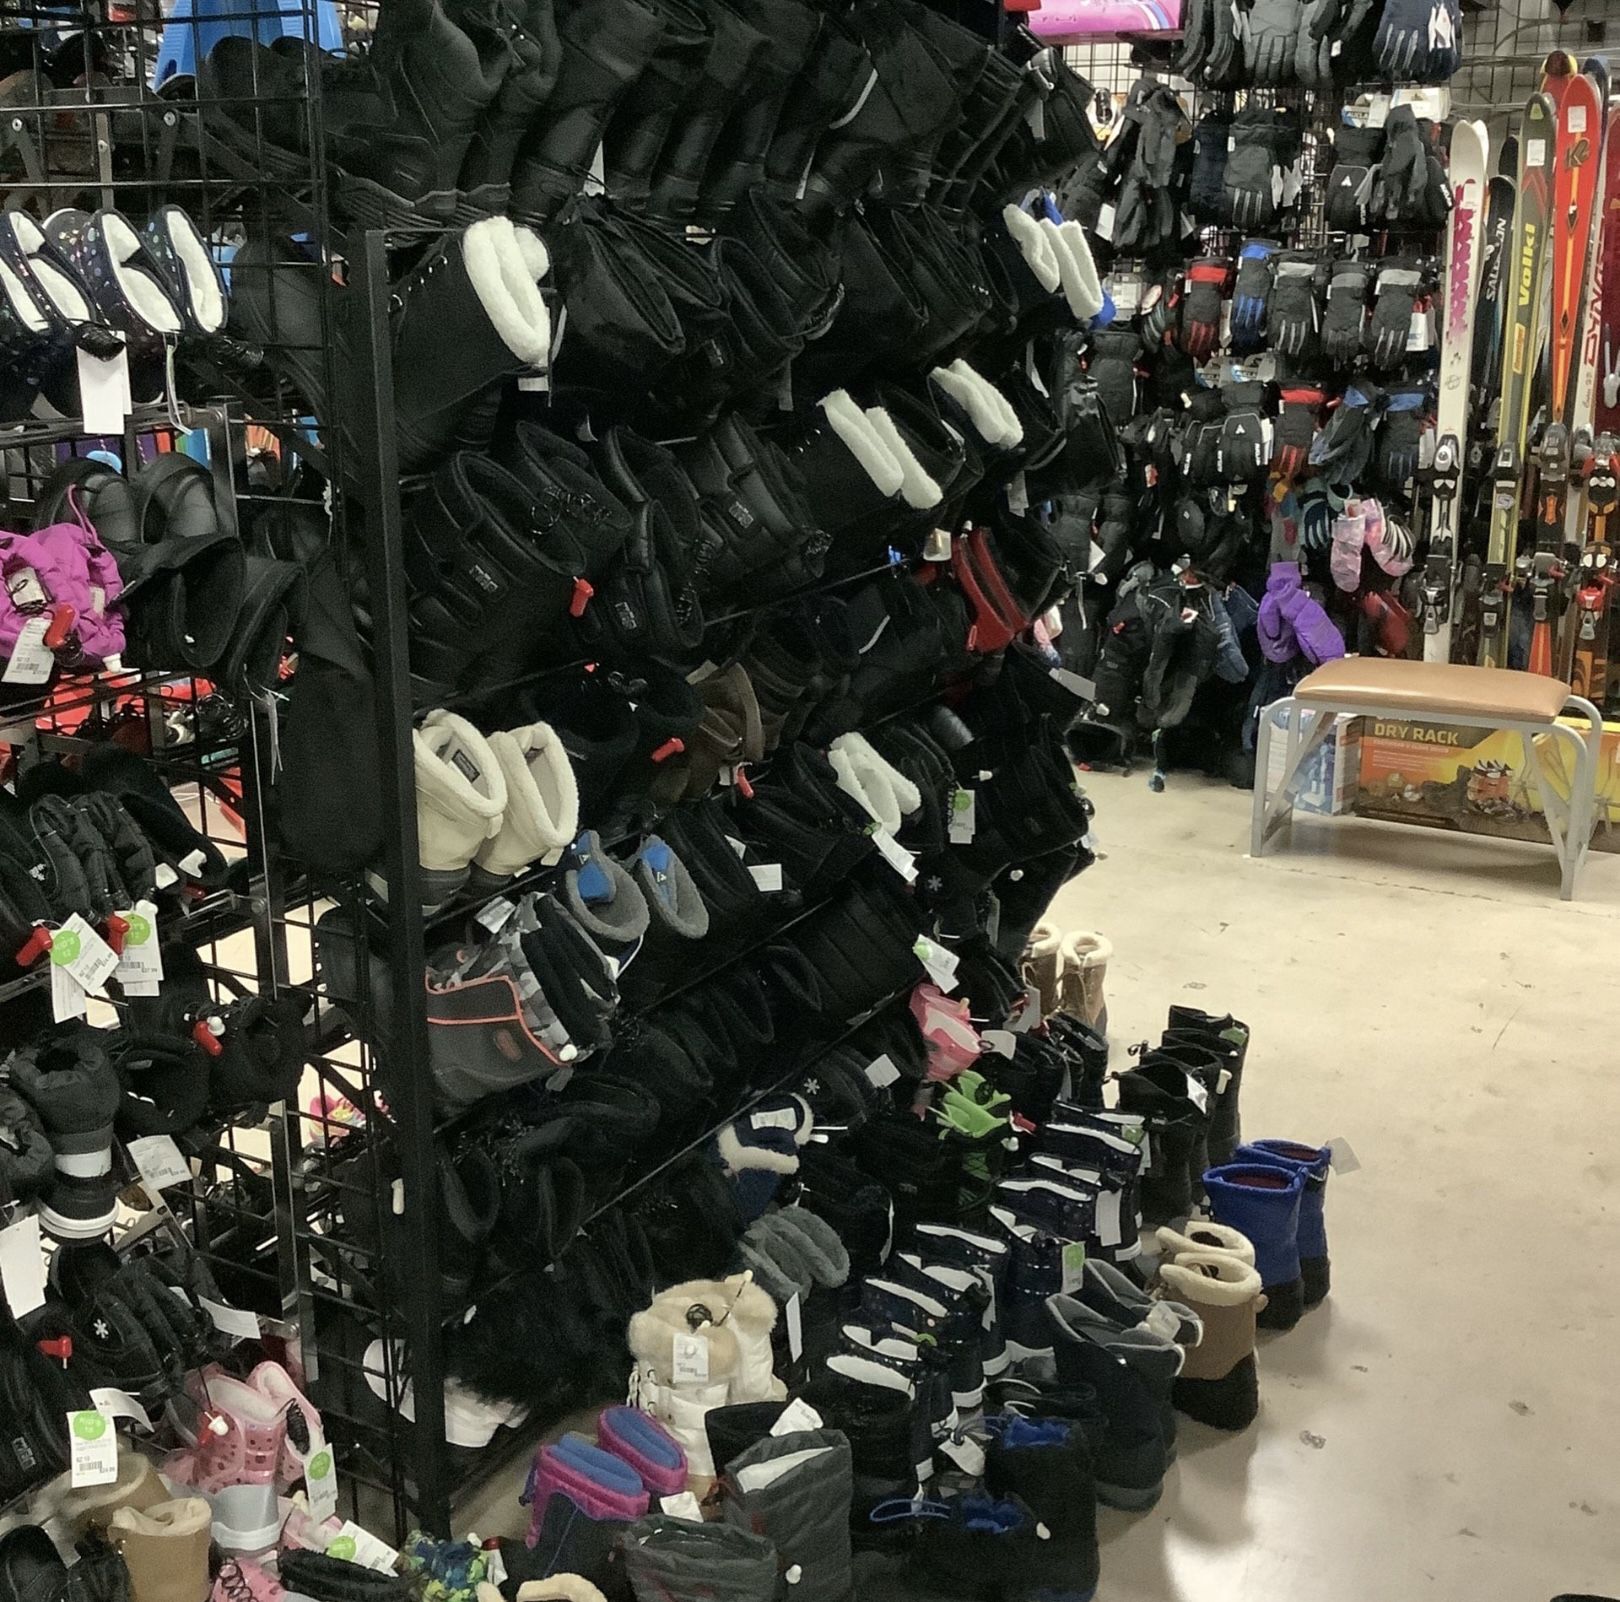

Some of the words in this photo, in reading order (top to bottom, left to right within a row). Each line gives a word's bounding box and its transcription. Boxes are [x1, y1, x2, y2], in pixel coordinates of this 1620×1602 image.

[1486, 217, 1507, 302] SALON
[1374, 723, 1409, 738] DRY
[1413, 727, 1459, 745] RACK
